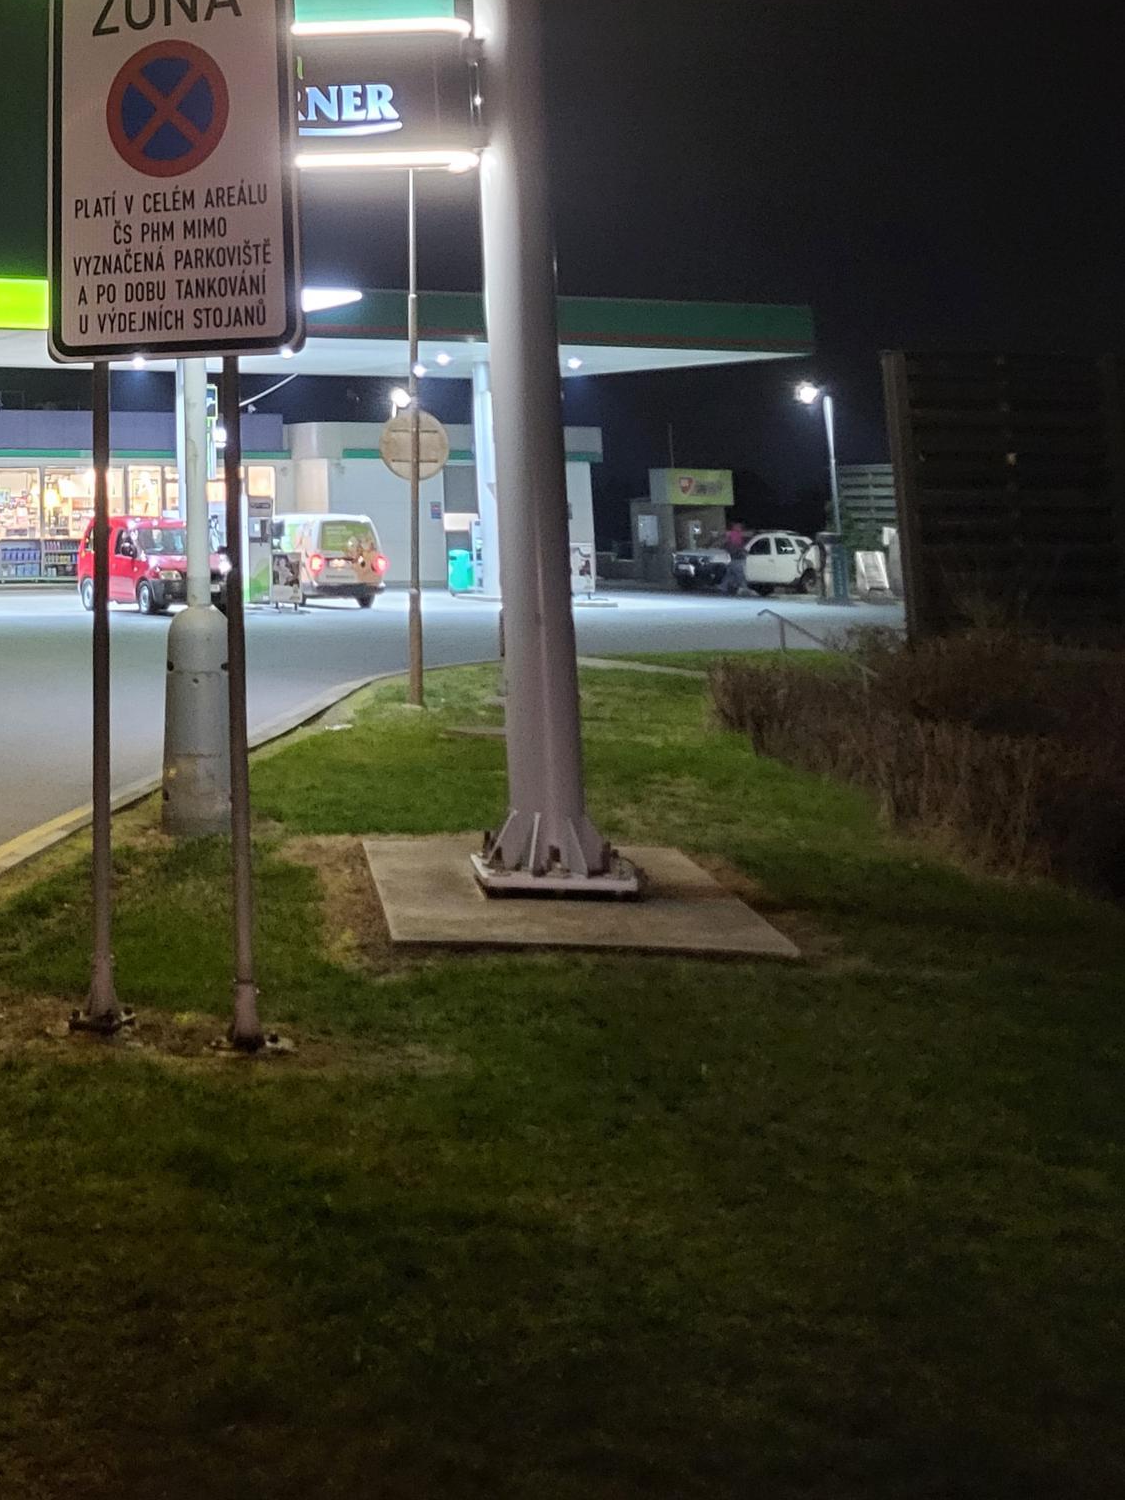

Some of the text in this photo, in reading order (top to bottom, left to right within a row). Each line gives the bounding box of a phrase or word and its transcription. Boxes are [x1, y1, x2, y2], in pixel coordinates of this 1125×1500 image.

[298, 84, 399, 121] NER
[75, 180, 267, 219] PLATÍ V CELÉM AREÁLU
[113, 217, 227, 245] ČS PHM MIMO
[73, 238, 271, 276] VYZNAČENÁ PARKOVIŠTĚ
[78, 268, 266, 306] A PO DOBU TANKOVÁNÍ
[79, 299, 266, 335] U VÝDEJNÍCH STOJANŮ
